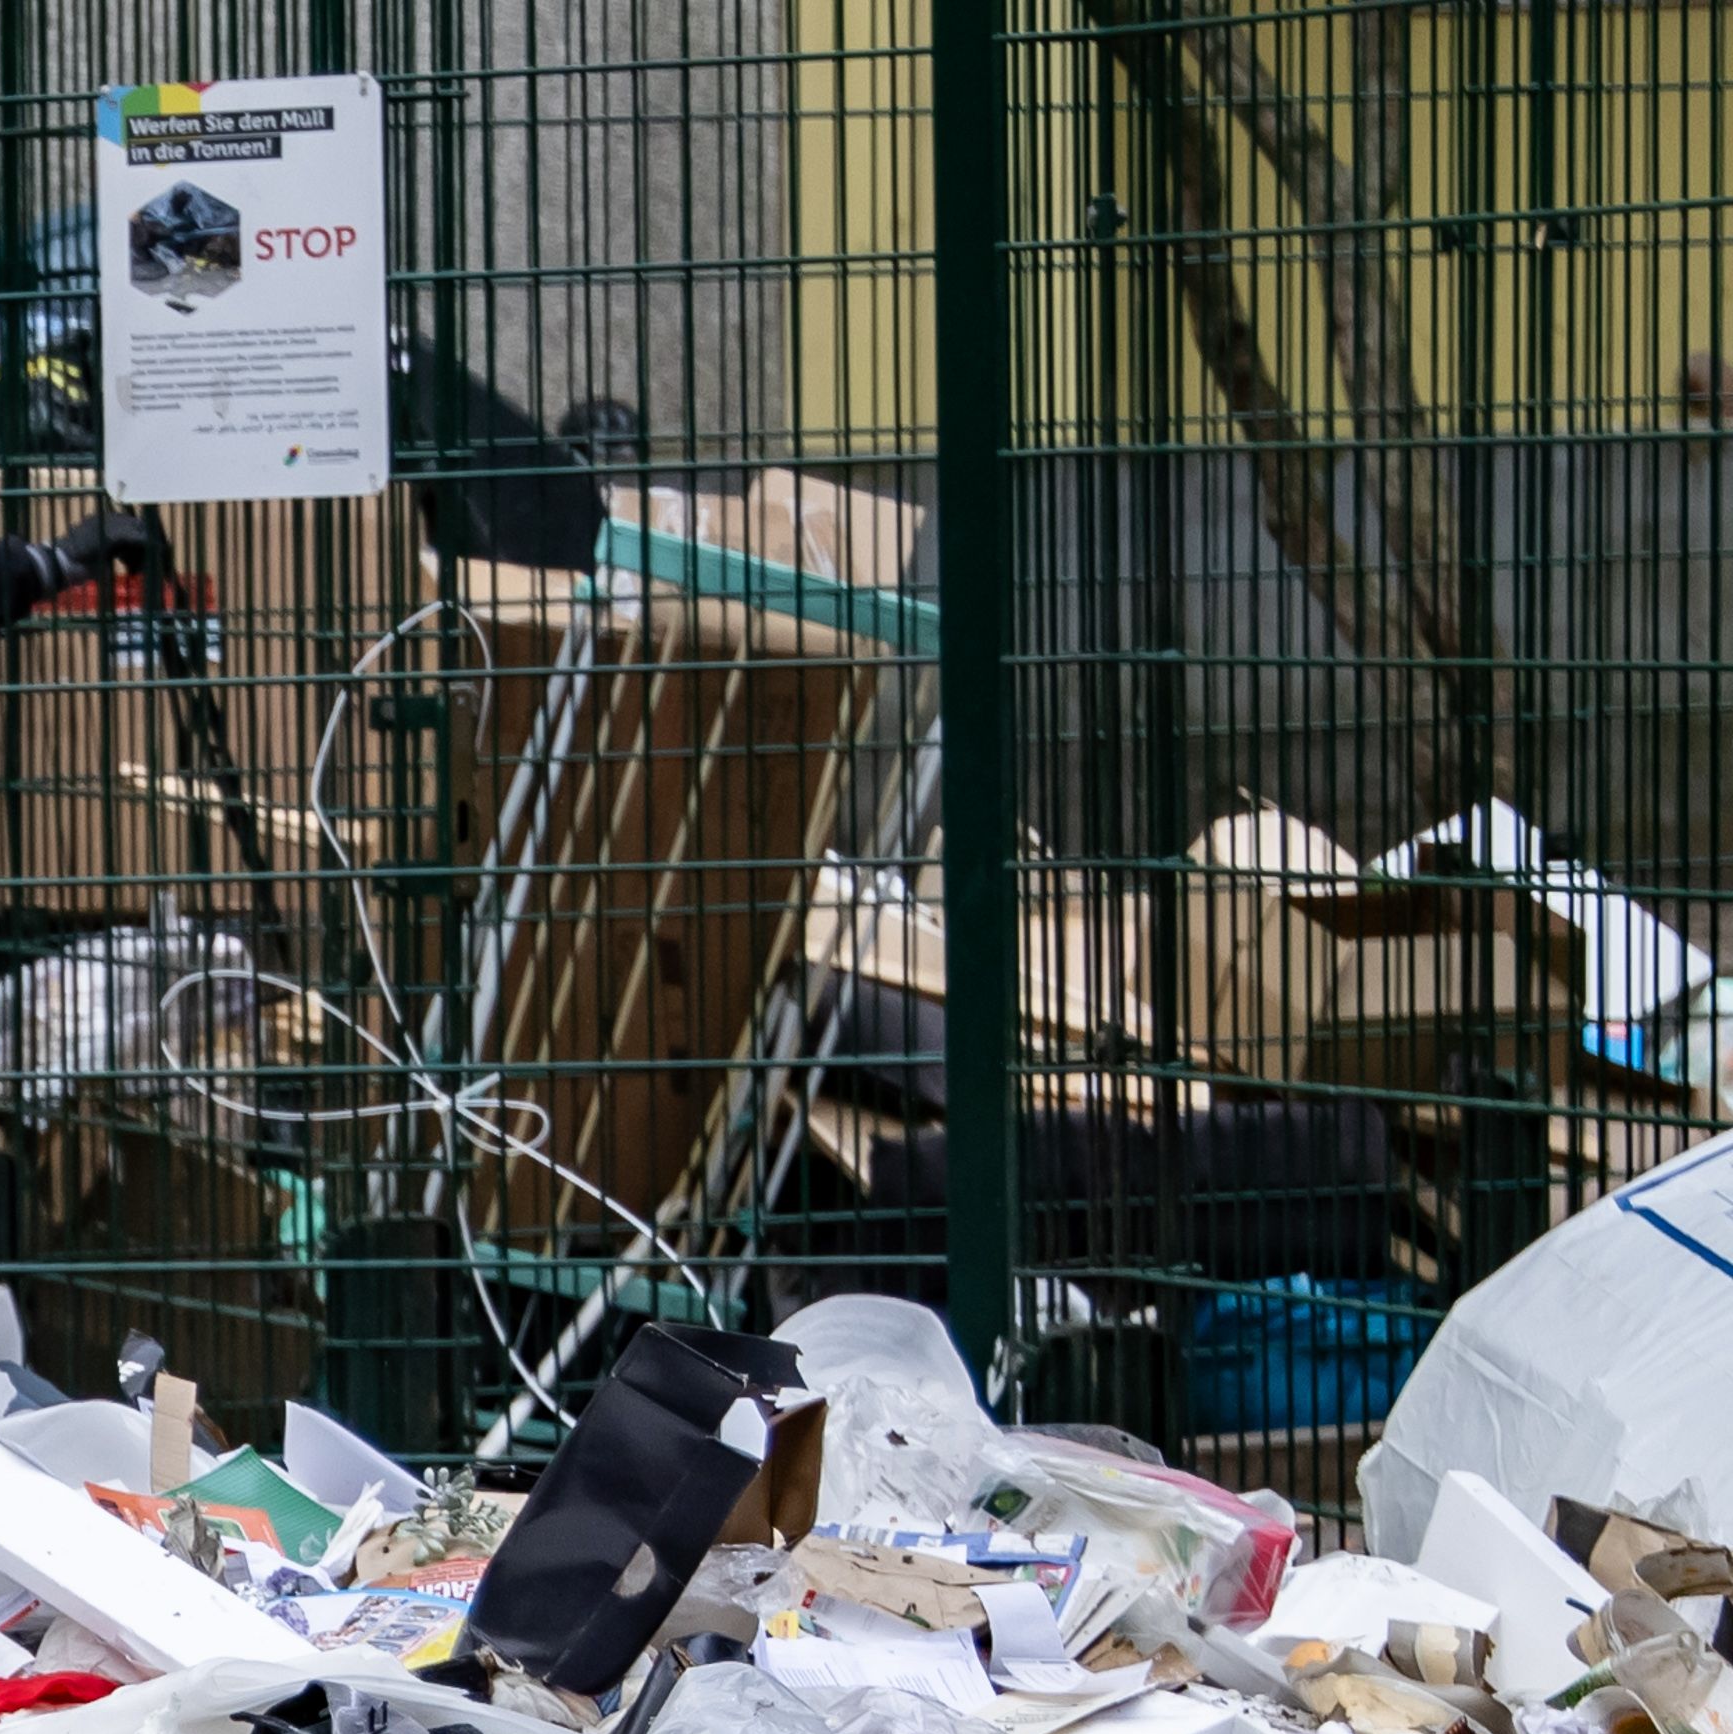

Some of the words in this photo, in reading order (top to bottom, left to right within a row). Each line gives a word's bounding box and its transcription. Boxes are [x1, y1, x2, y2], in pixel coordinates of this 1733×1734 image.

[129, 116, 202, 137] Werfen
[205, 113, 235, 133] Sie
[238, 111, 277, 131] den
[280, 107, 326, 129] Müll
[130, 144, 151, 162] in
[154, 141, 187, 161] die
[189, 137, 274, 159] Tonnen!
[255, 225, 358, 262] STOP
